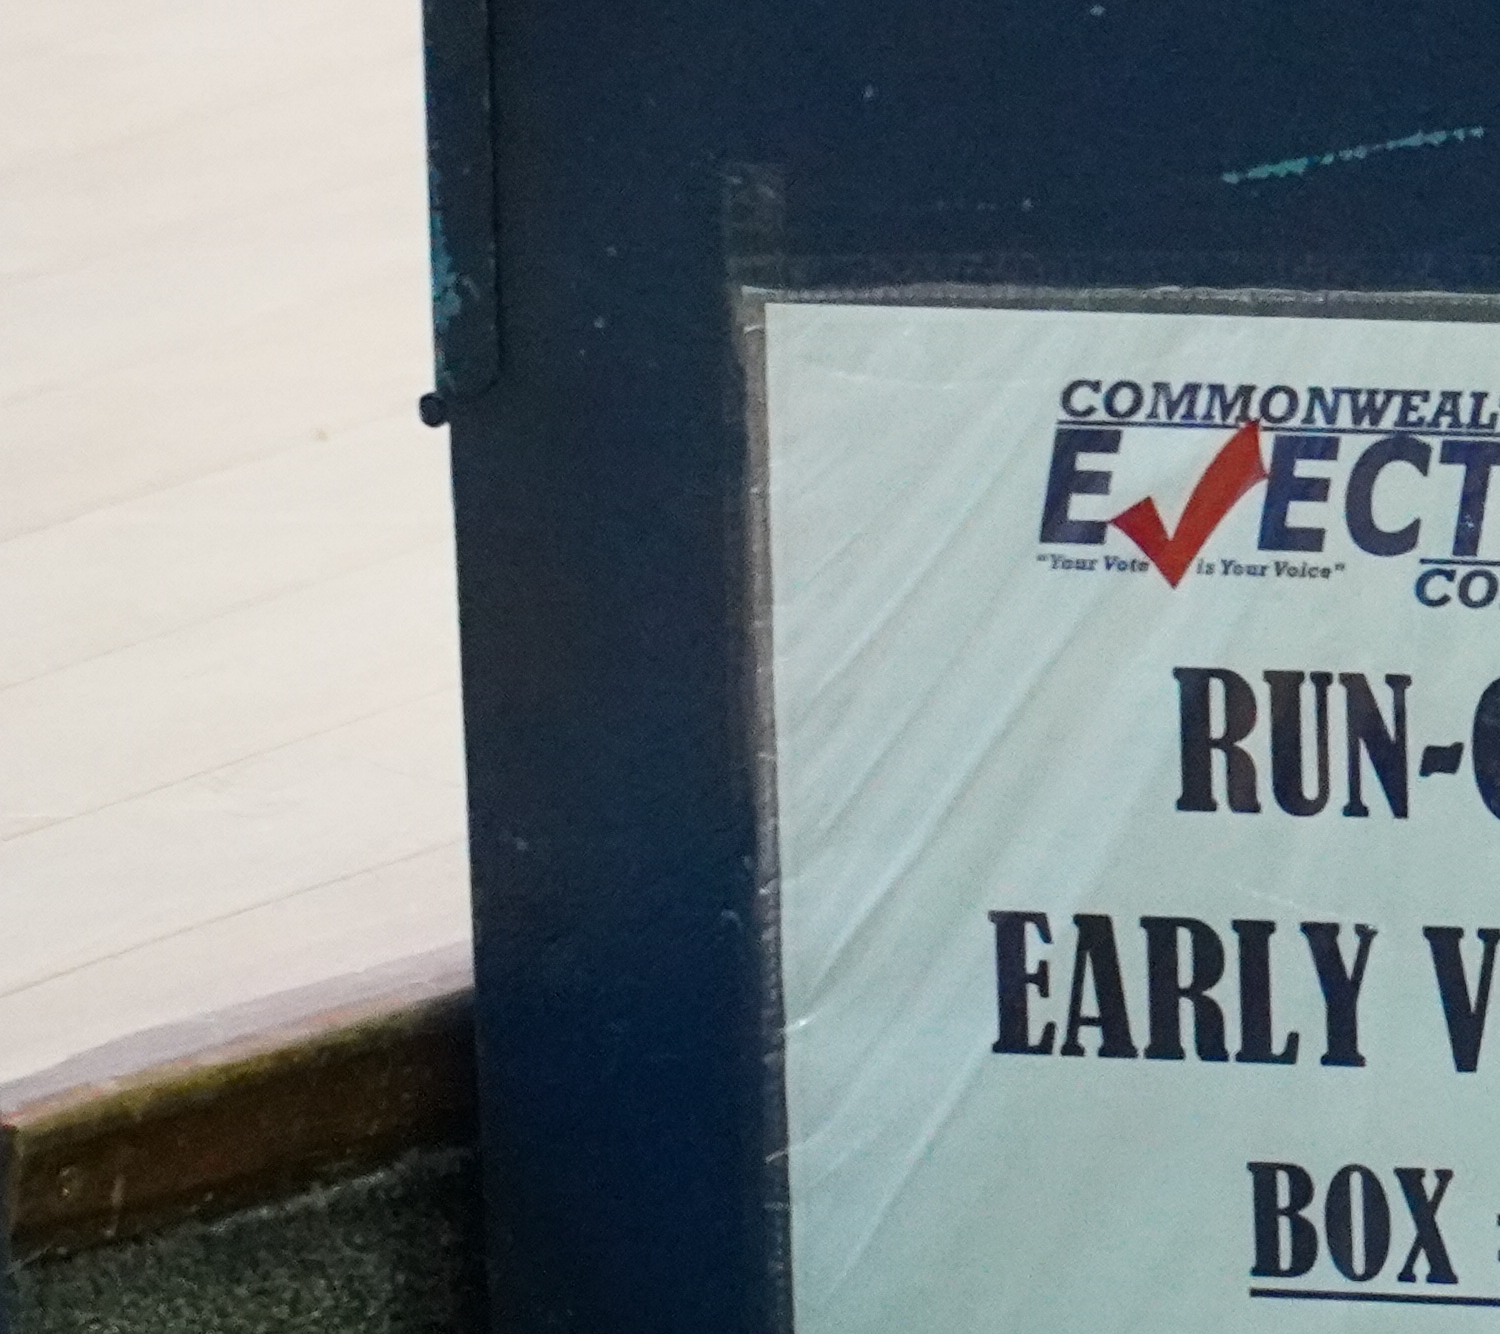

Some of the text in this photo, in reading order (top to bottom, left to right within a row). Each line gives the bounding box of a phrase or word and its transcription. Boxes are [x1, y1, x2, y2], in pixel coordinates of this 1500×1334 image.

[1103, 554, 1150, 574] Vote
[1220, 558, 1268, 578] Your
[988, 910, 1378, 1068] EARLY
[1247, 1161, 1459, 1285] BOX
